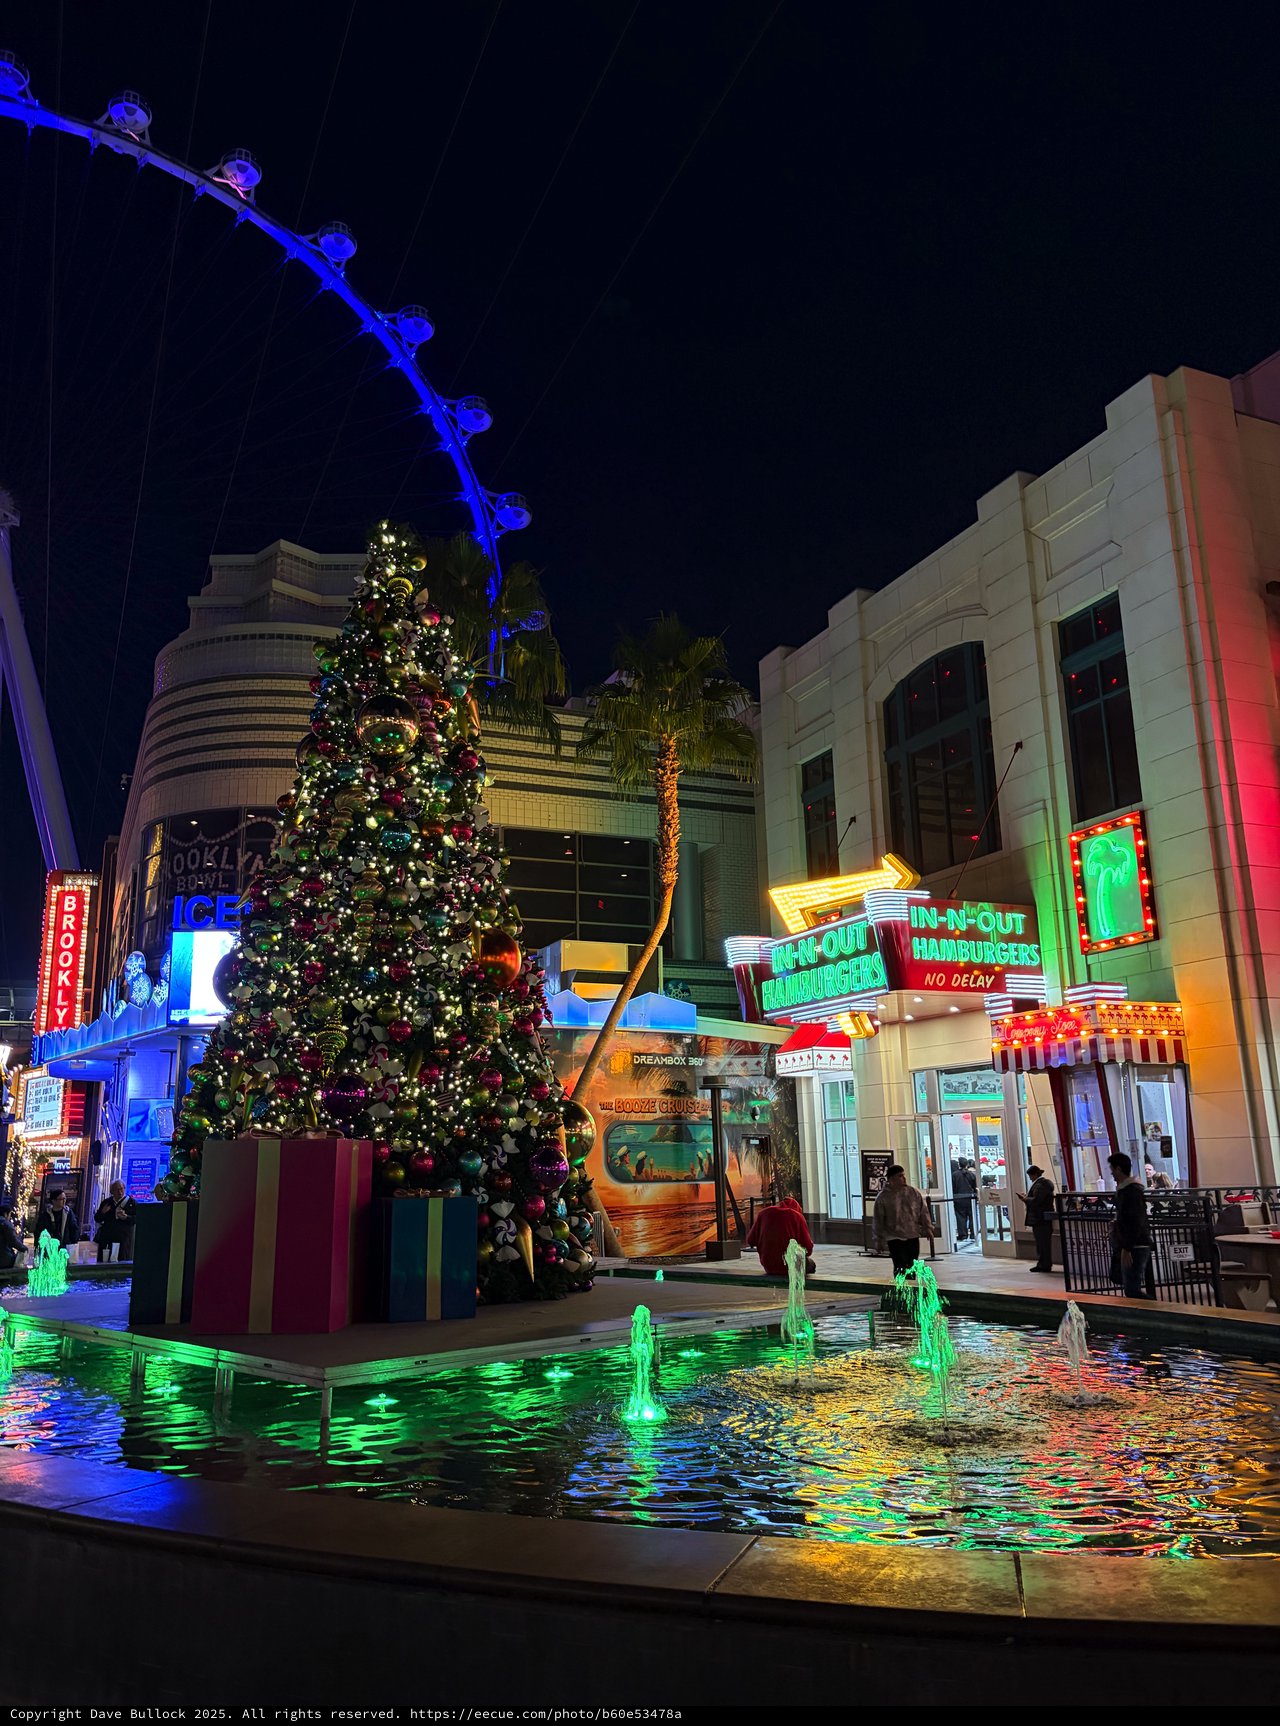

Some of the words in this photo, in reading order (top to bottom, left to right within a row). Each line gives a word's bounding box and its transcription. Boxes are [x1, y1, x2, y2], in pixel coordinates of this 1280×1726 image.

[168, 845, 265, 876] OOKLY
[176, 871, 229, 892] BOWL
[172, 895, 252, 929] ICE
[910, 905, 1027, 935] IN-N-OUT
[771, 921, 868, 974] IN-N-OUT
[912, 936, 1041, 967] HAMBURGERS
[761, 951, 887, 1011] HAMBURGERS
[924, 972, 946, 987] NO
[951, 973, 995, 988] DELAY
[1004, 1018, 1048, 1042] Company
[1051, 1014, 1078, 1034] Store
[633, 1055, 686, 1066] DREAMBOX
[599, 1101, 613, 1111] THE
[615, 1098, 657, 1114] BOOZE
[659, 1099, 701, 1114] CRUISE
